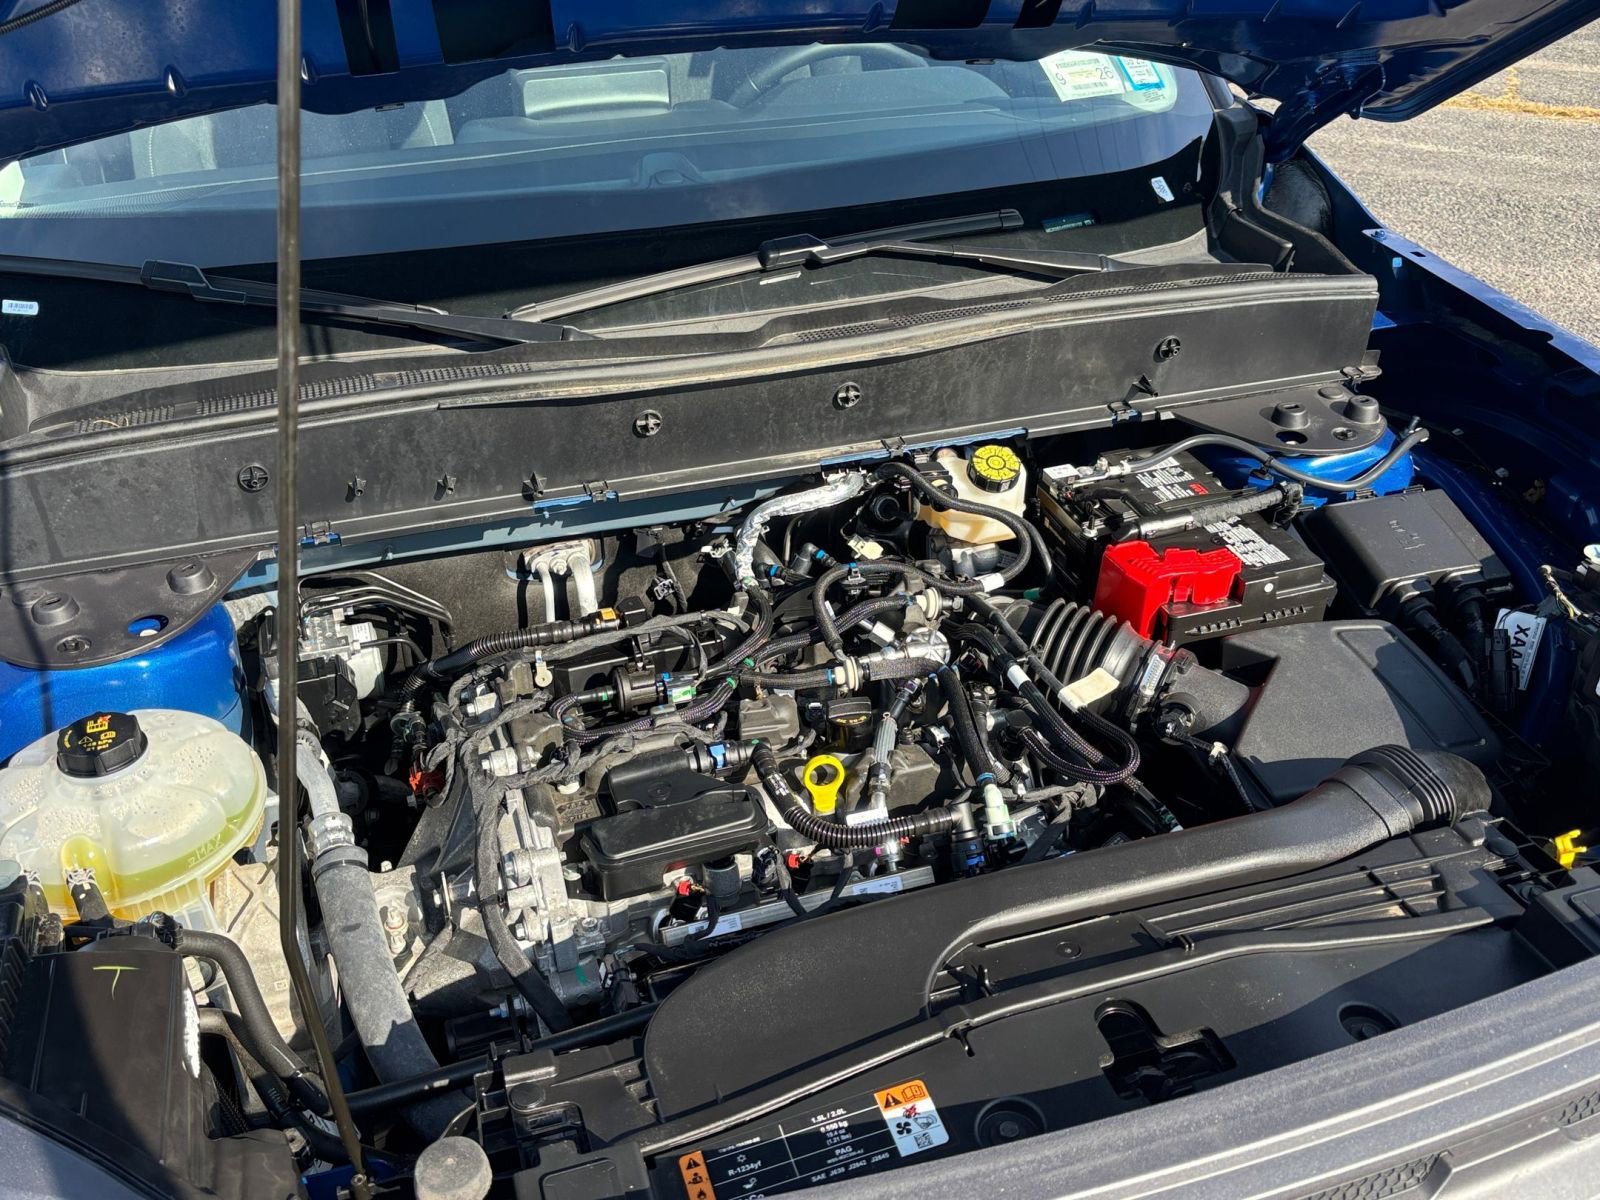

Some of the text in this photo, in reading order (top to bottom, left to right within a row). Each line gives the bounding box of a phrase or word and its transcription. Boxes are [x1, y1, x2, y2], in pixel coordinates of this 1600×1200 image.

[1096, 66, 1114, 80] 26
[834, 1145, 853, 1156] PAG
[728, 1160, 762, 1176] R-1234yf
[811, 1172, 827, 1183] SAE
